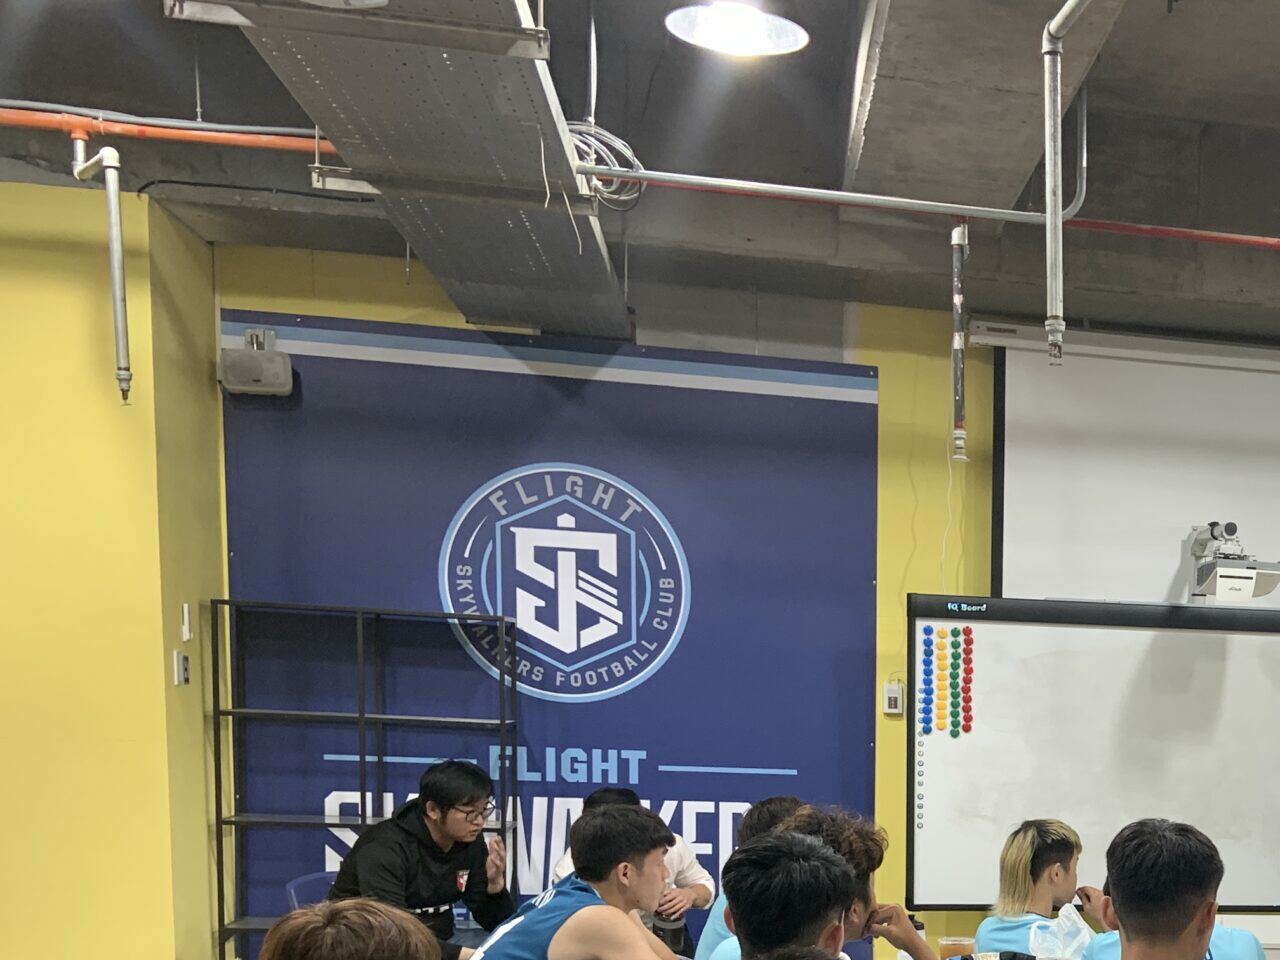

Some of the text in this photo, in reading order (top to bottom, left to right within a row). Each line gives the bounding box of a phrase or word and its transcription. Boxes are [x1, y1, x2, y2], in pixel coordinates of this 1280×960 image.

[488, 474, 643, 522] FLIGHT
[556, 640, 658, 687] FOOTBALL
[652, 577, 675, 631] CLUB
[489, 745, 647, 784] FLIGHT
